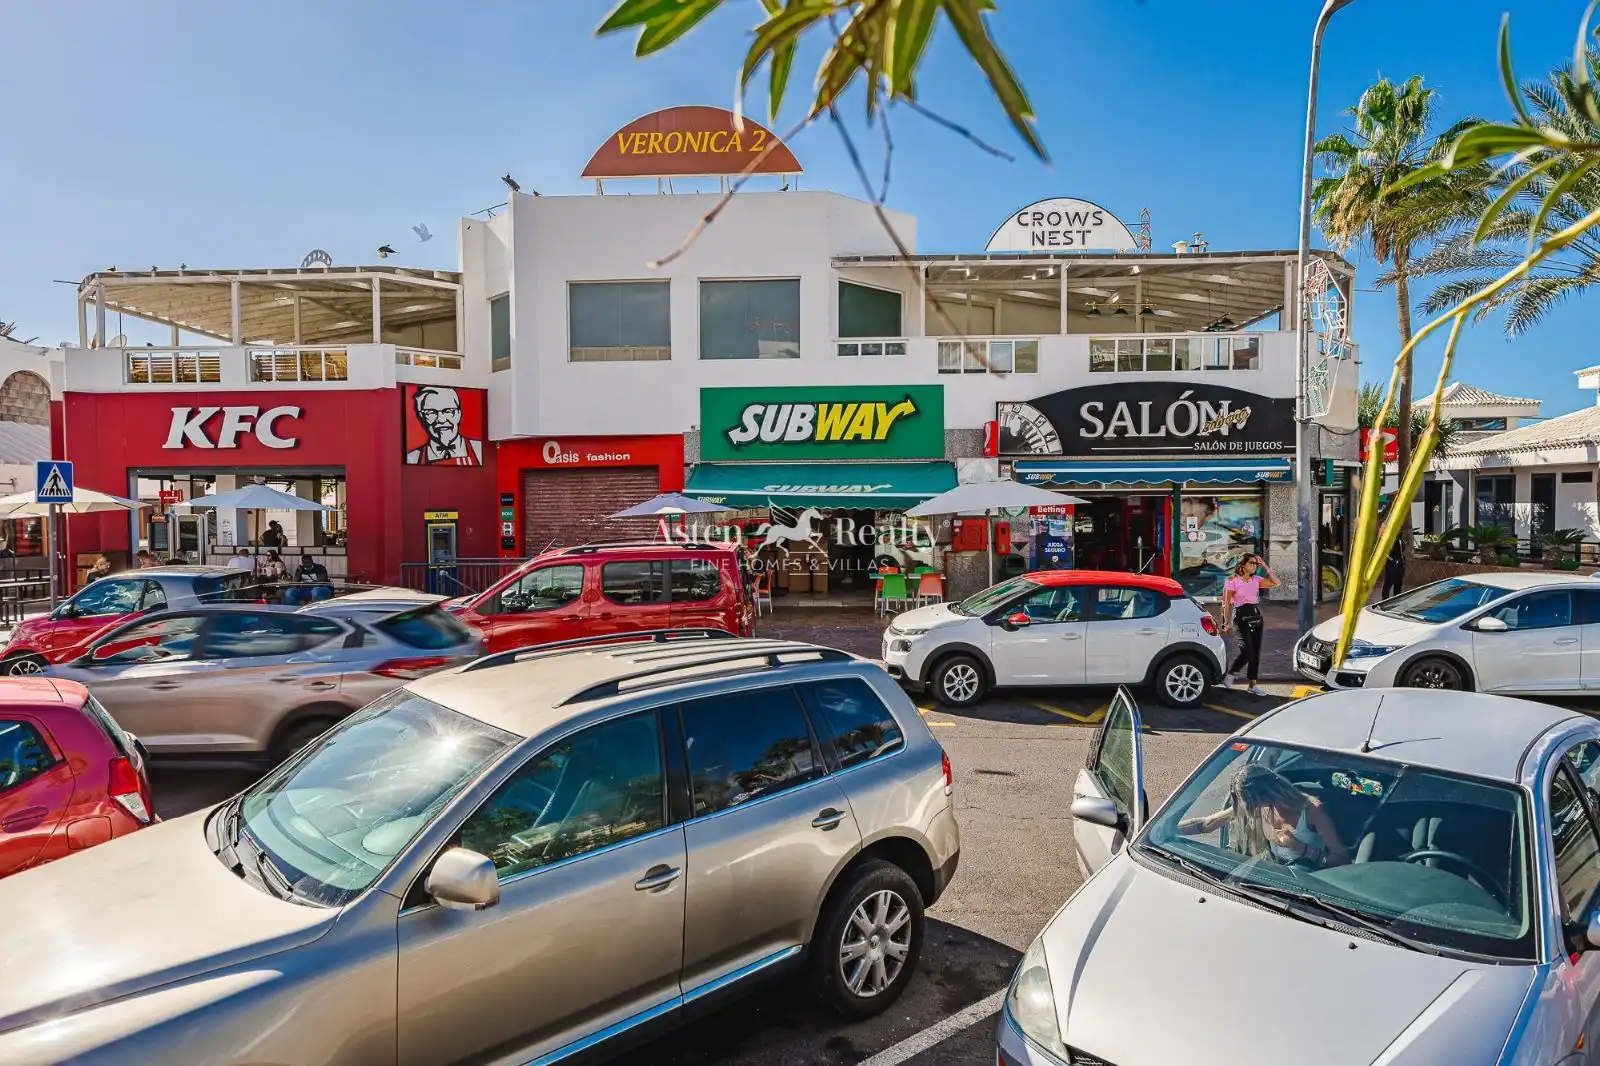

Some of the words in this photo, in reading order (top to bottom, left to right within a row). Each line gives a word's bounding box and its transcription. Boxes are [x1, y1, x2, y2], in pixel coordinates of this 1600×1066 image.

[617, 130, 743, 155] VERONICA
[749, 130, 767, 152] 2
[1017, 211, 1103, 226] CROWS
[1032, 230, 1092, 246] NEST
[728, 398, 916, 445] SUBWAY
[1079, 390, 1231, 437] SALÓN
[162, 406, 301, 450] KFC
[543, 441, 580, 464] Oasis
[586, 452, 631, 462] fashion
[1193, 440, 1226, 451] SALÓN
[1230, 441, 1242, 450] DE
[1245, 441, 1283, 451] JUEGOS
[1025, 473, 1056, 481] SUBWAY
[756, 483, 894, 493] SUBWAY
[1037, 506, 1066, 514] Betting
